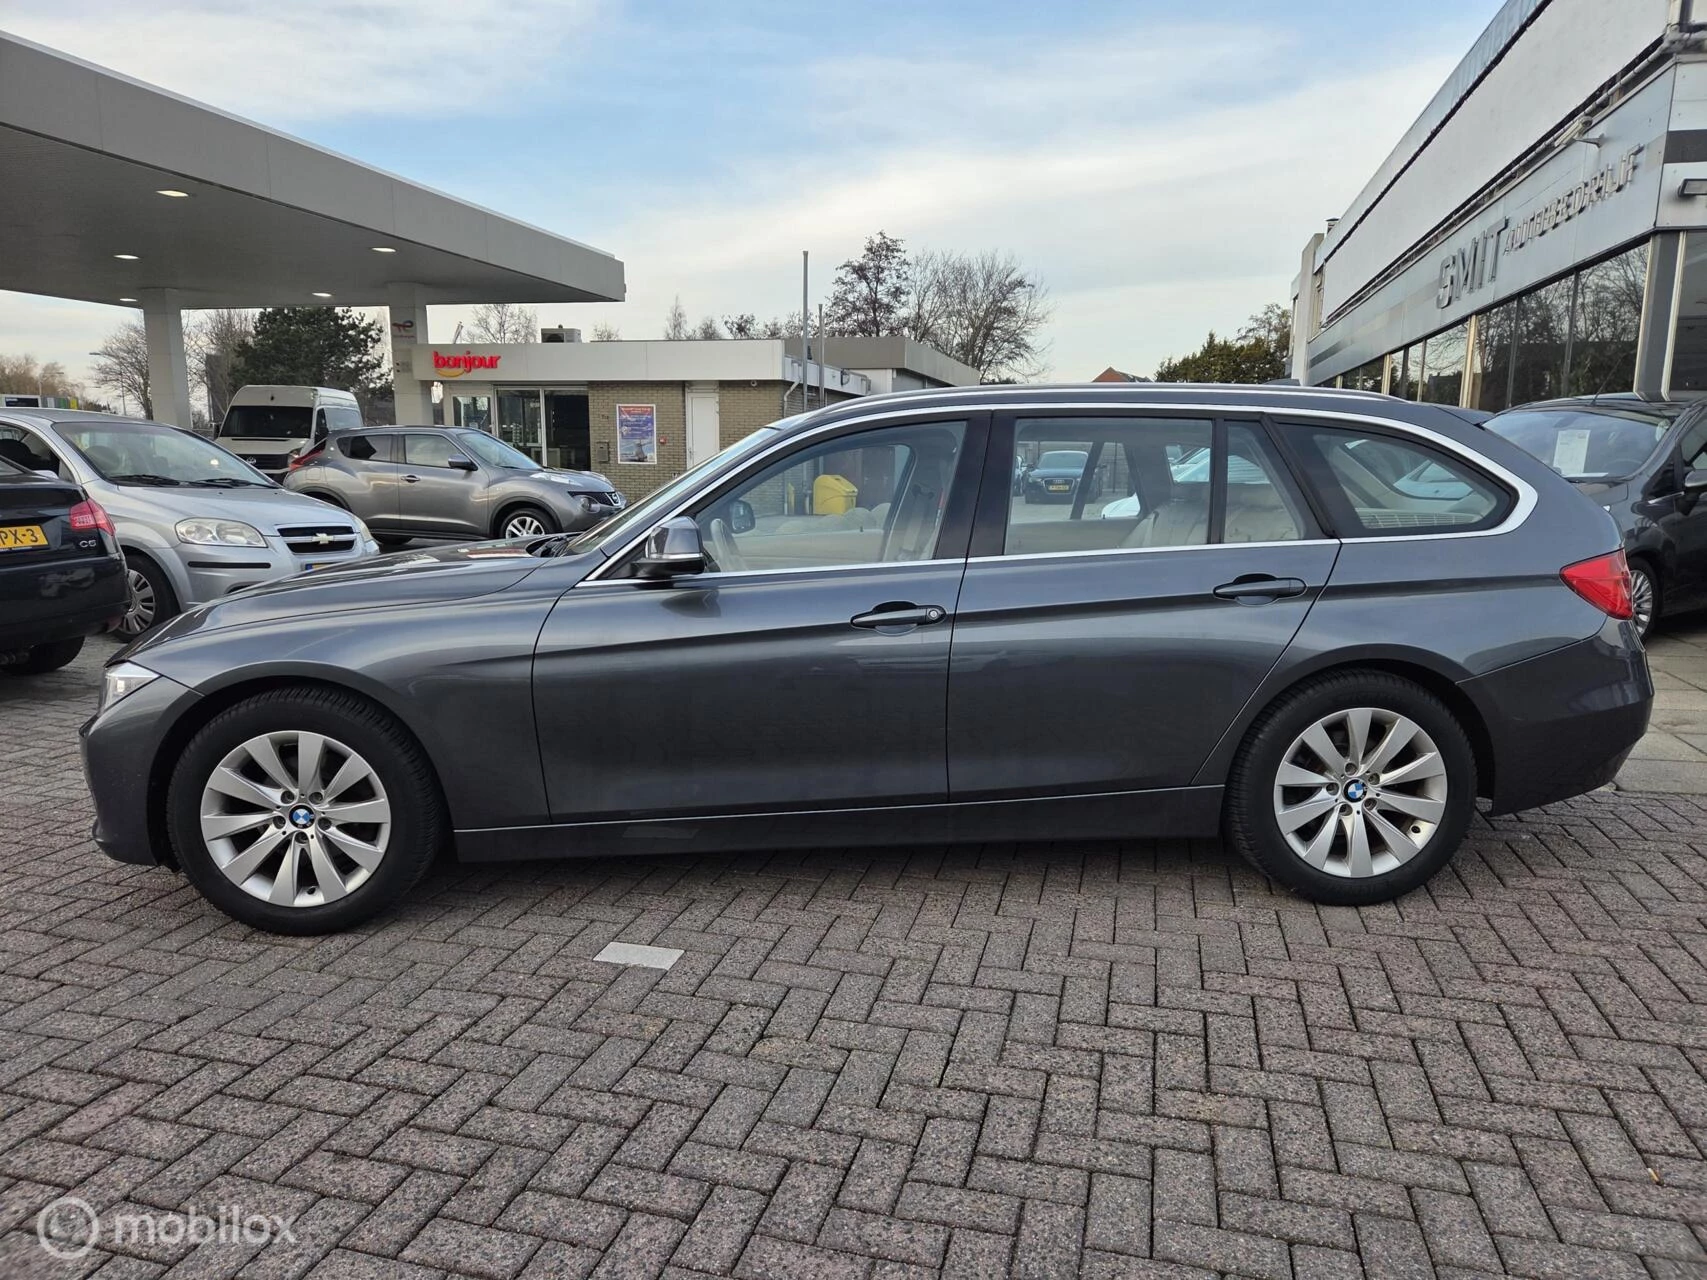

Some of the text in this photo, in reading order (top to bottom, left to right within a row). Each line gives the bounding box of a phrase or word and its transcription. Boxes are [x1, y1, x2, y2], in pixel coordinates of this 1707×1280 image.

[1436, 216, 1508, 309] SMIT
[433, 350, 501, 373] bonjour
[79, 540, 97, 548] C5
